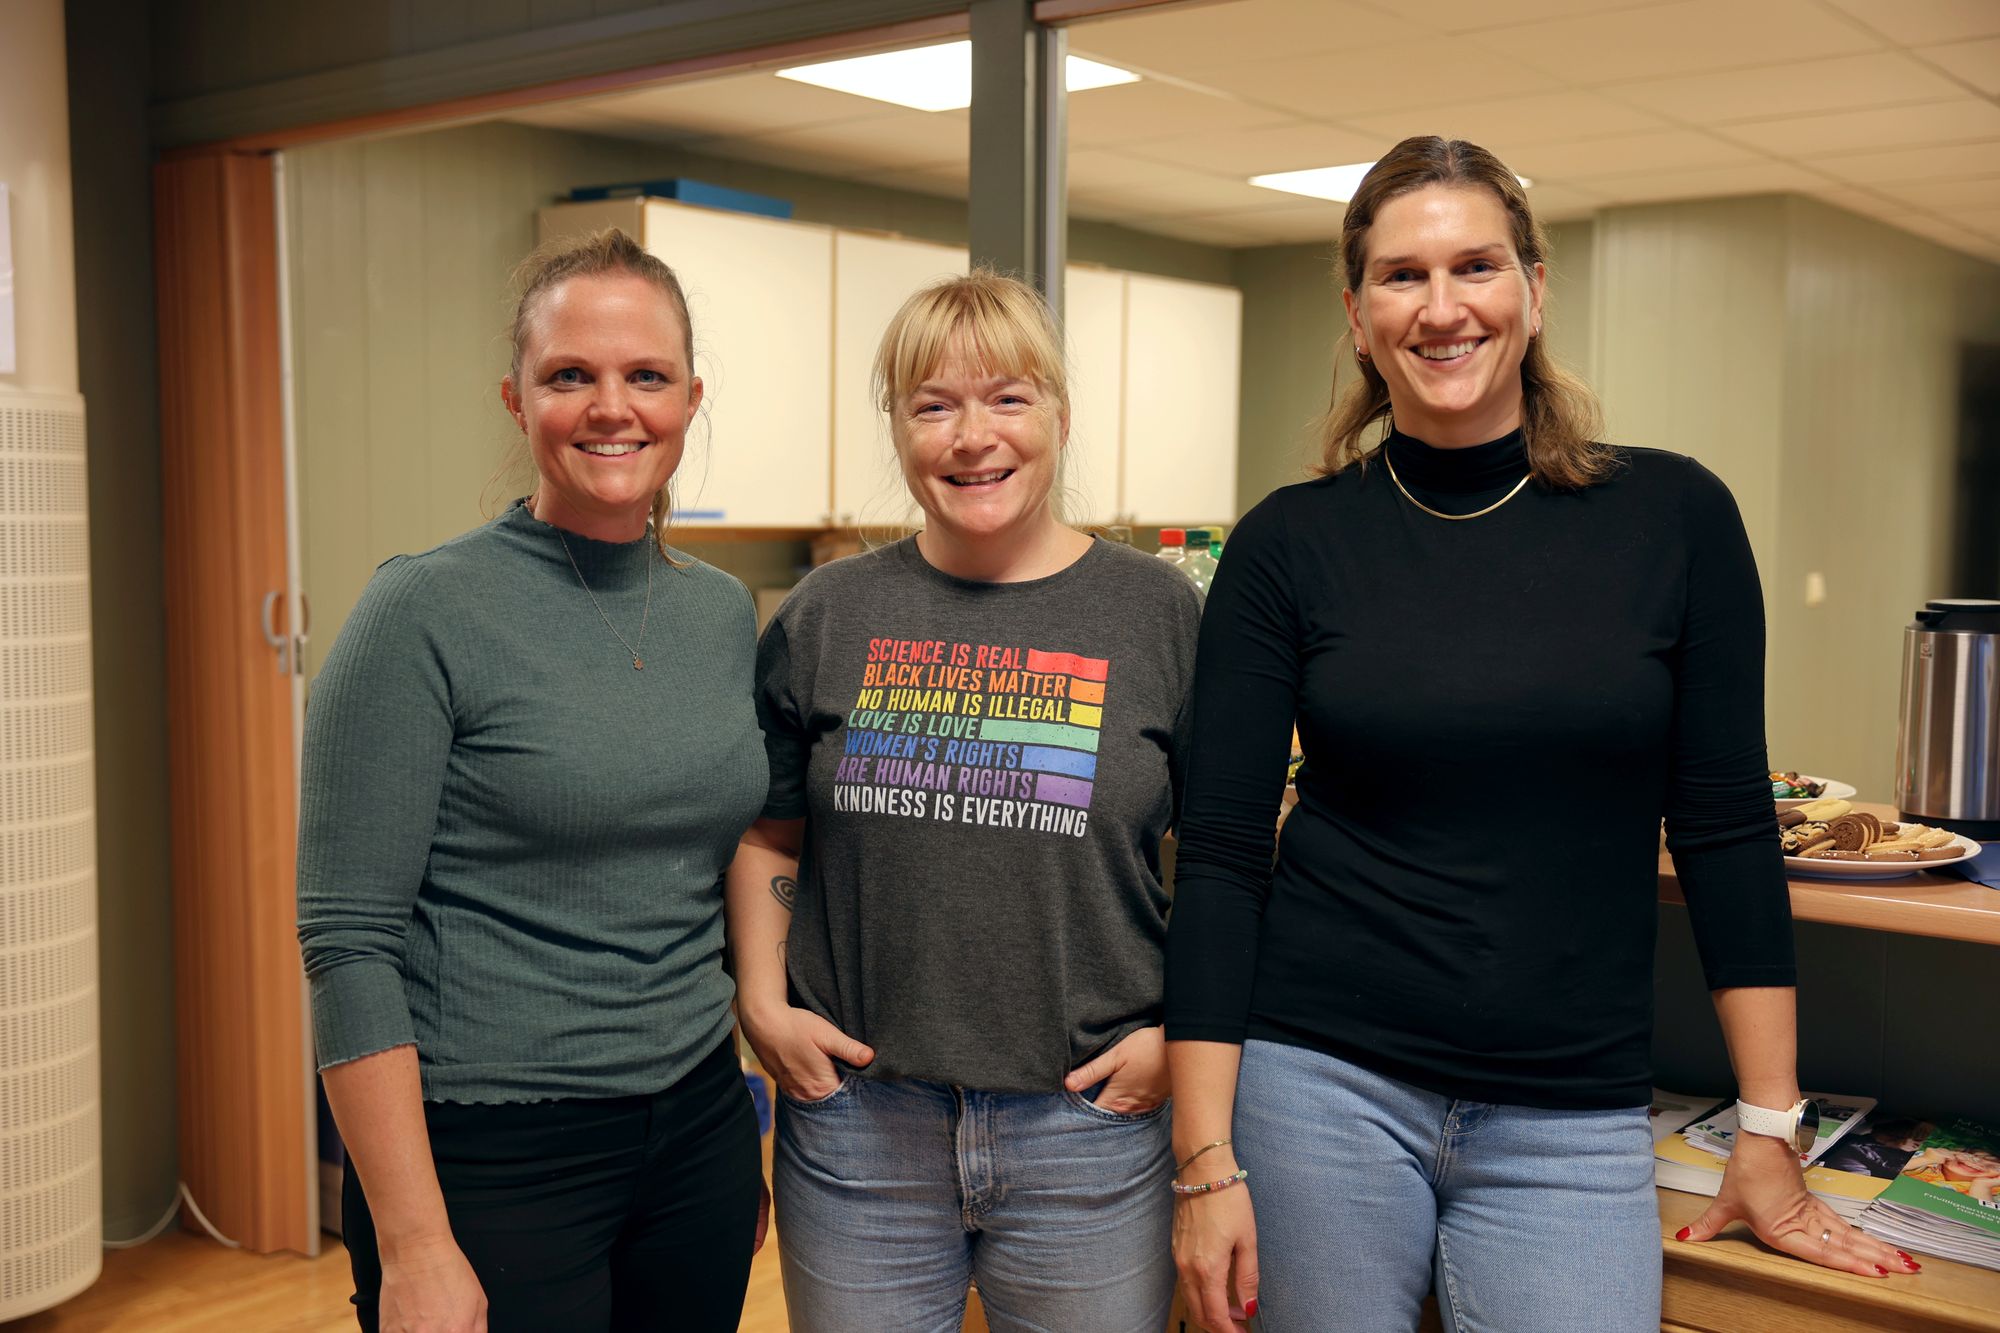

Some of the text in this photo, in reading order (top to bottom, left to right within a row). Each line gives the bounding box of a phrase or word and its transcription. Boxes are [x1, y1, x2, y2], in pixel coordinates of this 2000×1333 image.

[867, 639, 1023, 670] SCIENCE IS REAL
[863, 663, 1067, 697] BLACK LIVES MATTER
[856, 689, 1066, 722] NO HUMAN IS ILLEGAL
[848, 709, 978, 739] LOVE IS LOVE
[844, 730, 1020, 769] WOMEN'S RIGHTS
[835, 756, 1034, 799] ARE HUMAN RIGHTS
[834, 785, 1088, 837] KINDNESS IS EVERYTHING
